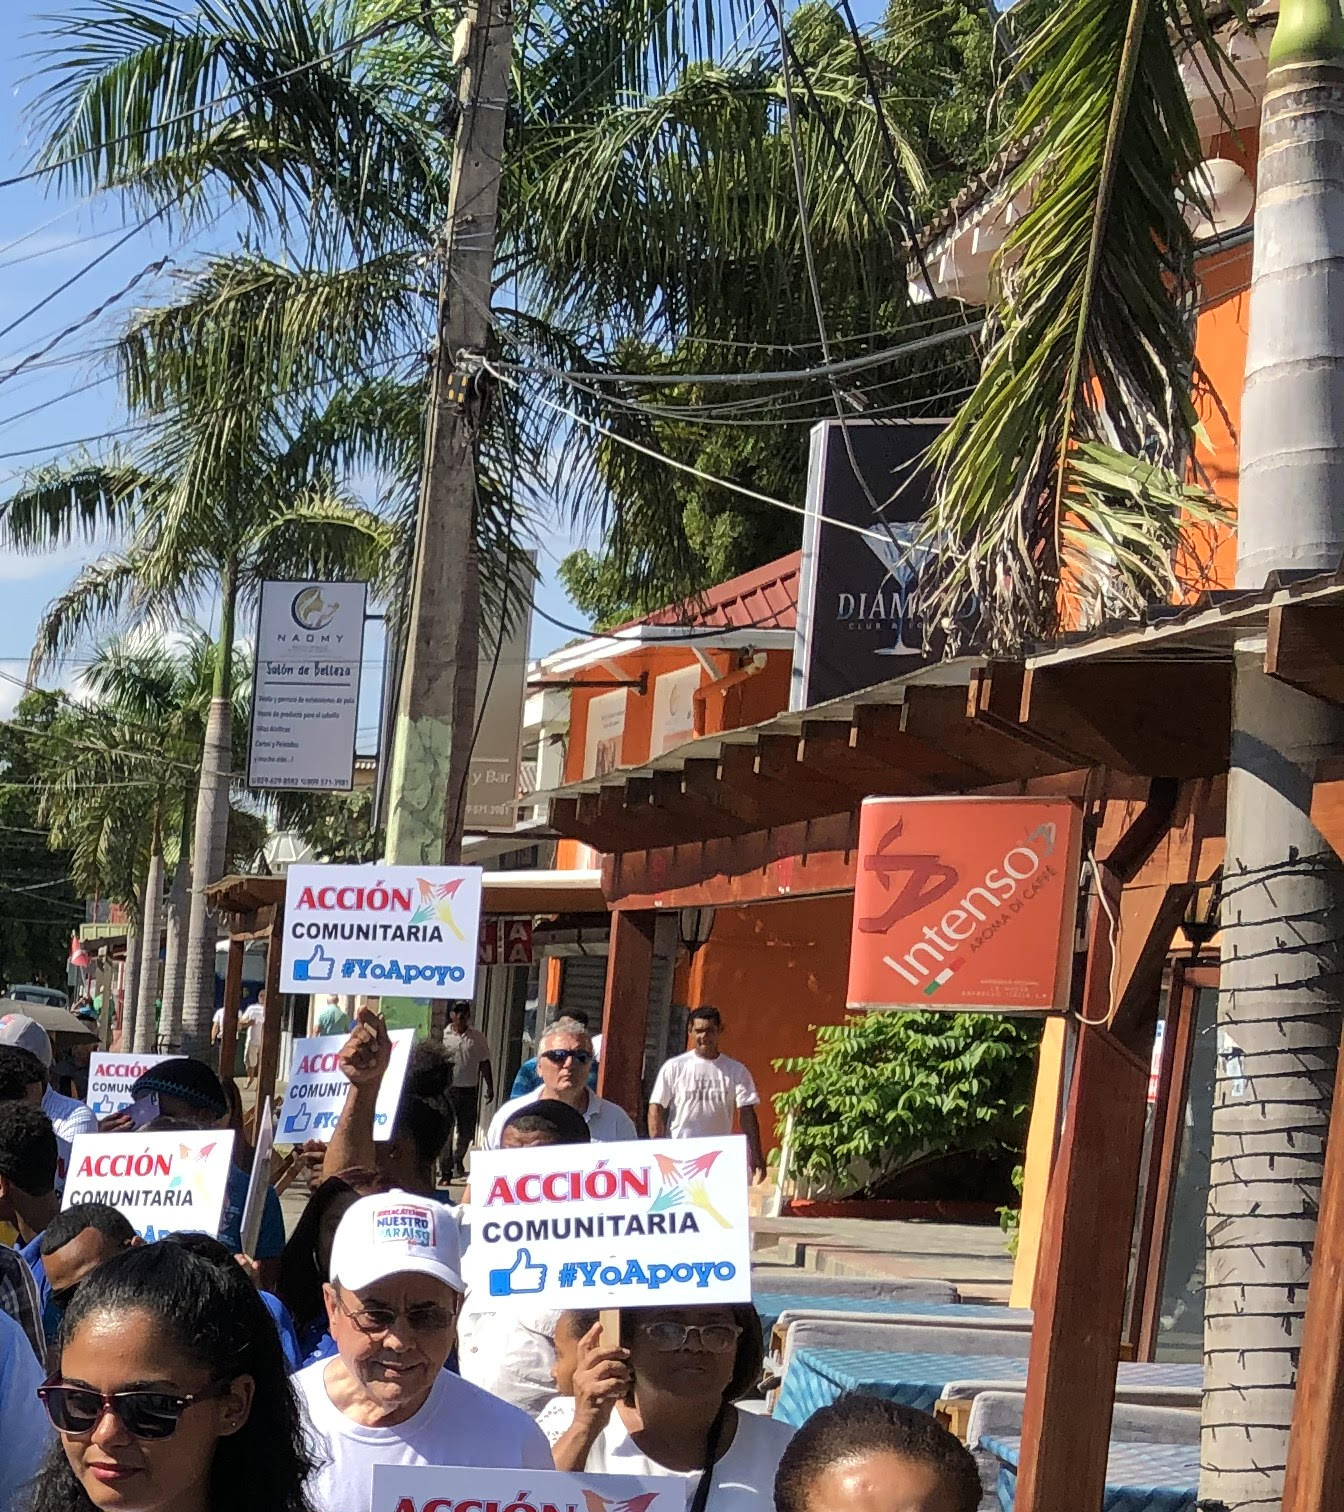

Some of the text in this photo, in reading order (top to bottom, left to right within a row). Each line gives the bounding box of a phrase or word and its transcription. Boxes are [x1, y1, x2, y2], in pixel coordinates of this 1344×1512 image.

[277, 634, 343, 643] NAOMY
[267, 661, 350, 676] Salón de Belleza
[486, 770, 511, 783] Bar
[295, 880, 414, 912] ACCIÓN
[882, 847, 1039, 986] Intenso
[291, 922, 443, 943] COMUNITARIA
[969, 913, 1010, 953] AROMA
[341, 959, 465, 986] #YoApoyo
[77, 1147, 173, 1178] ACCIÓN
[70, 1190, 193, 1207] COMUNITARIA
[484, 1161, 651, 1208] ACCIÓN
[377, 1217, 429, 1229] NUESTRO
[482, 1211, 700, 1244] COMUNITARIA
[559, 1258, 736, 1293] #YoApoyo
